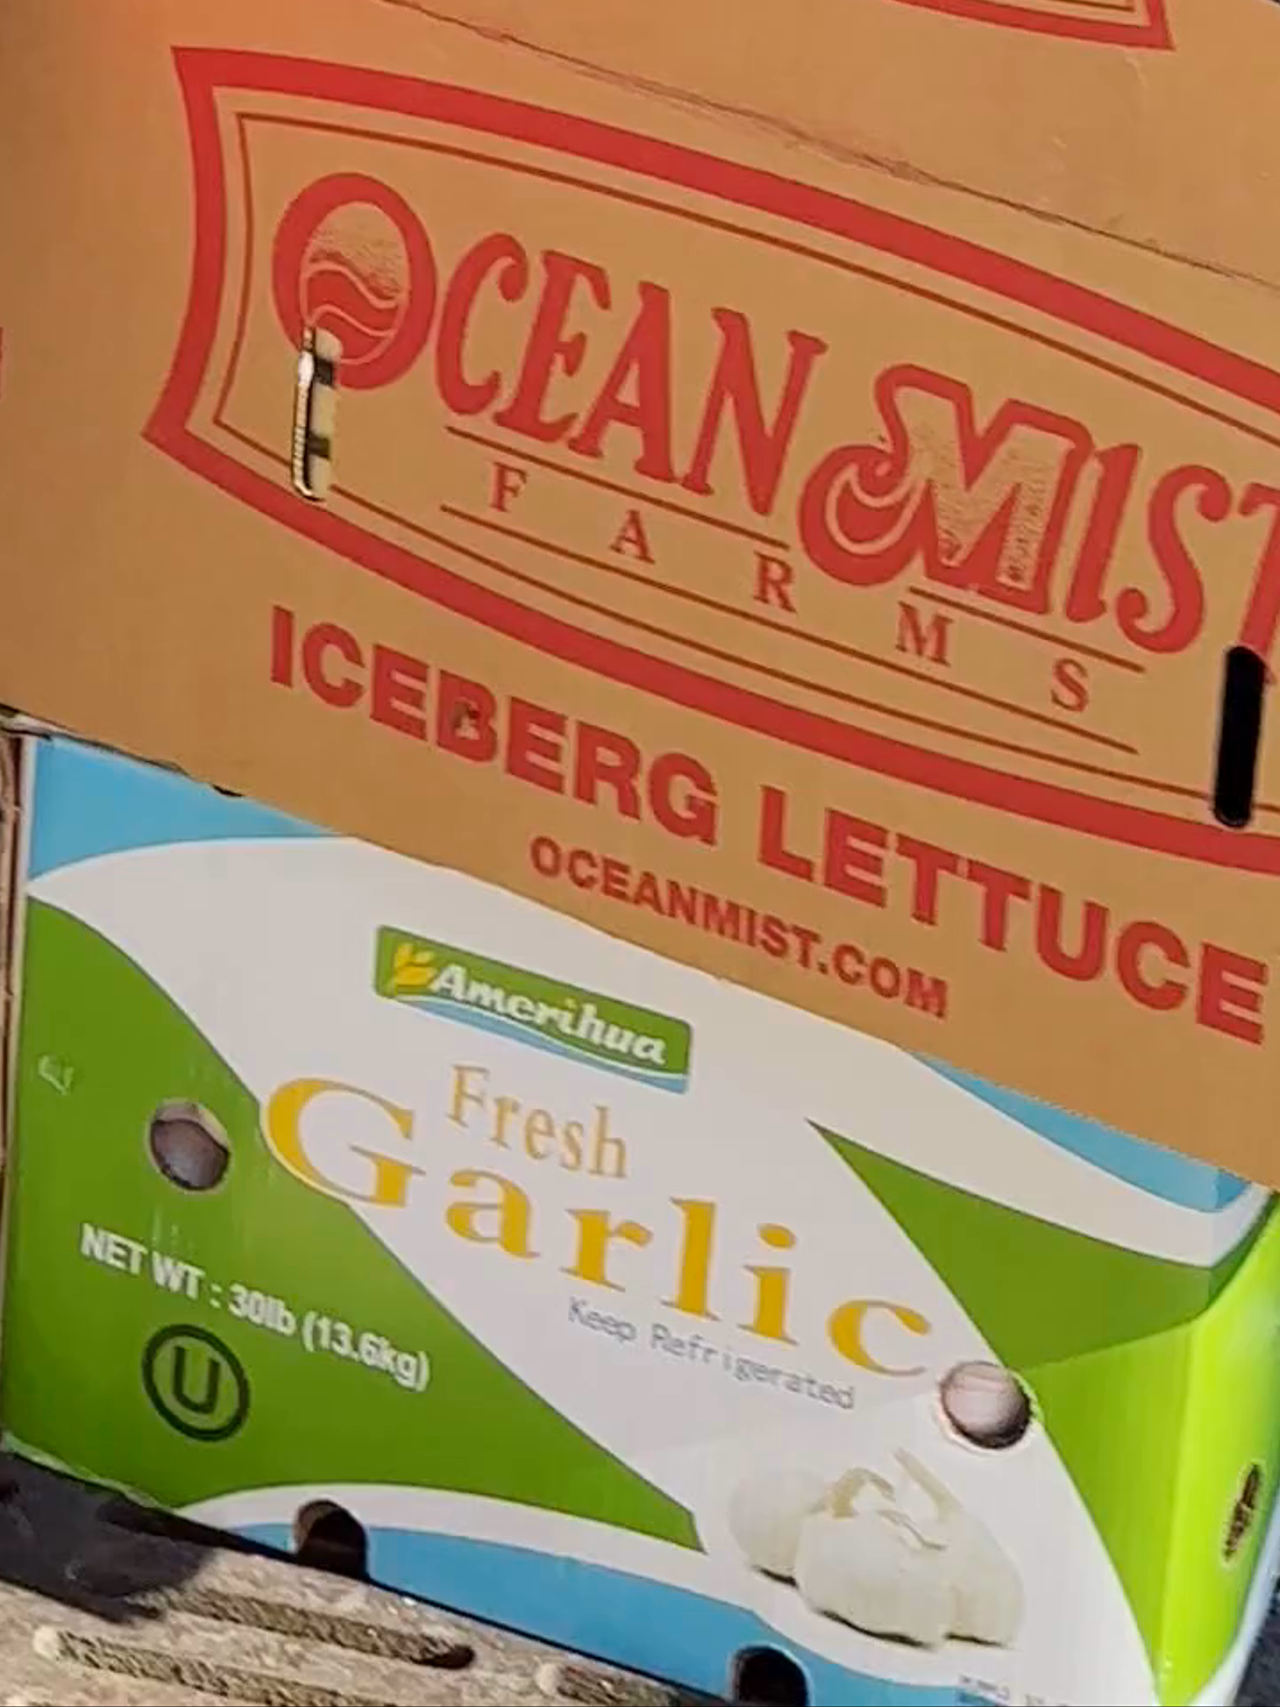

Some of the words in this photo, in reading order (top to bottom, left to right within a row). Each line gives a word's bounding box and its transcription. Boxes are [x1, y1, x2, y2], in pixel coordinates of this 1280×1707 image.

[271, 172, 829, 520] OCEAN
[269, 606, 718, 845] ICEBERG
[758, 784, 1270, 1045] LETTUCE
[429, 963, 667, 1068] Amerihua
[528, 833, 950, 1021] OCEANMIST.COM
[445, 1063, 629, 1180] Fresh
[80, 1222, 147, 1276] NET
[153, 1250, 206, 1300] WT
[229, 1282, 298, 1336] 30lb
[303, 1310, 431, 1392] (13.6kg)
[267, 1076, 932, 1377] Garlic
[568, 1297, 638, 1346] Keep
[650, 1322, 857, 1411] Refrigerated
